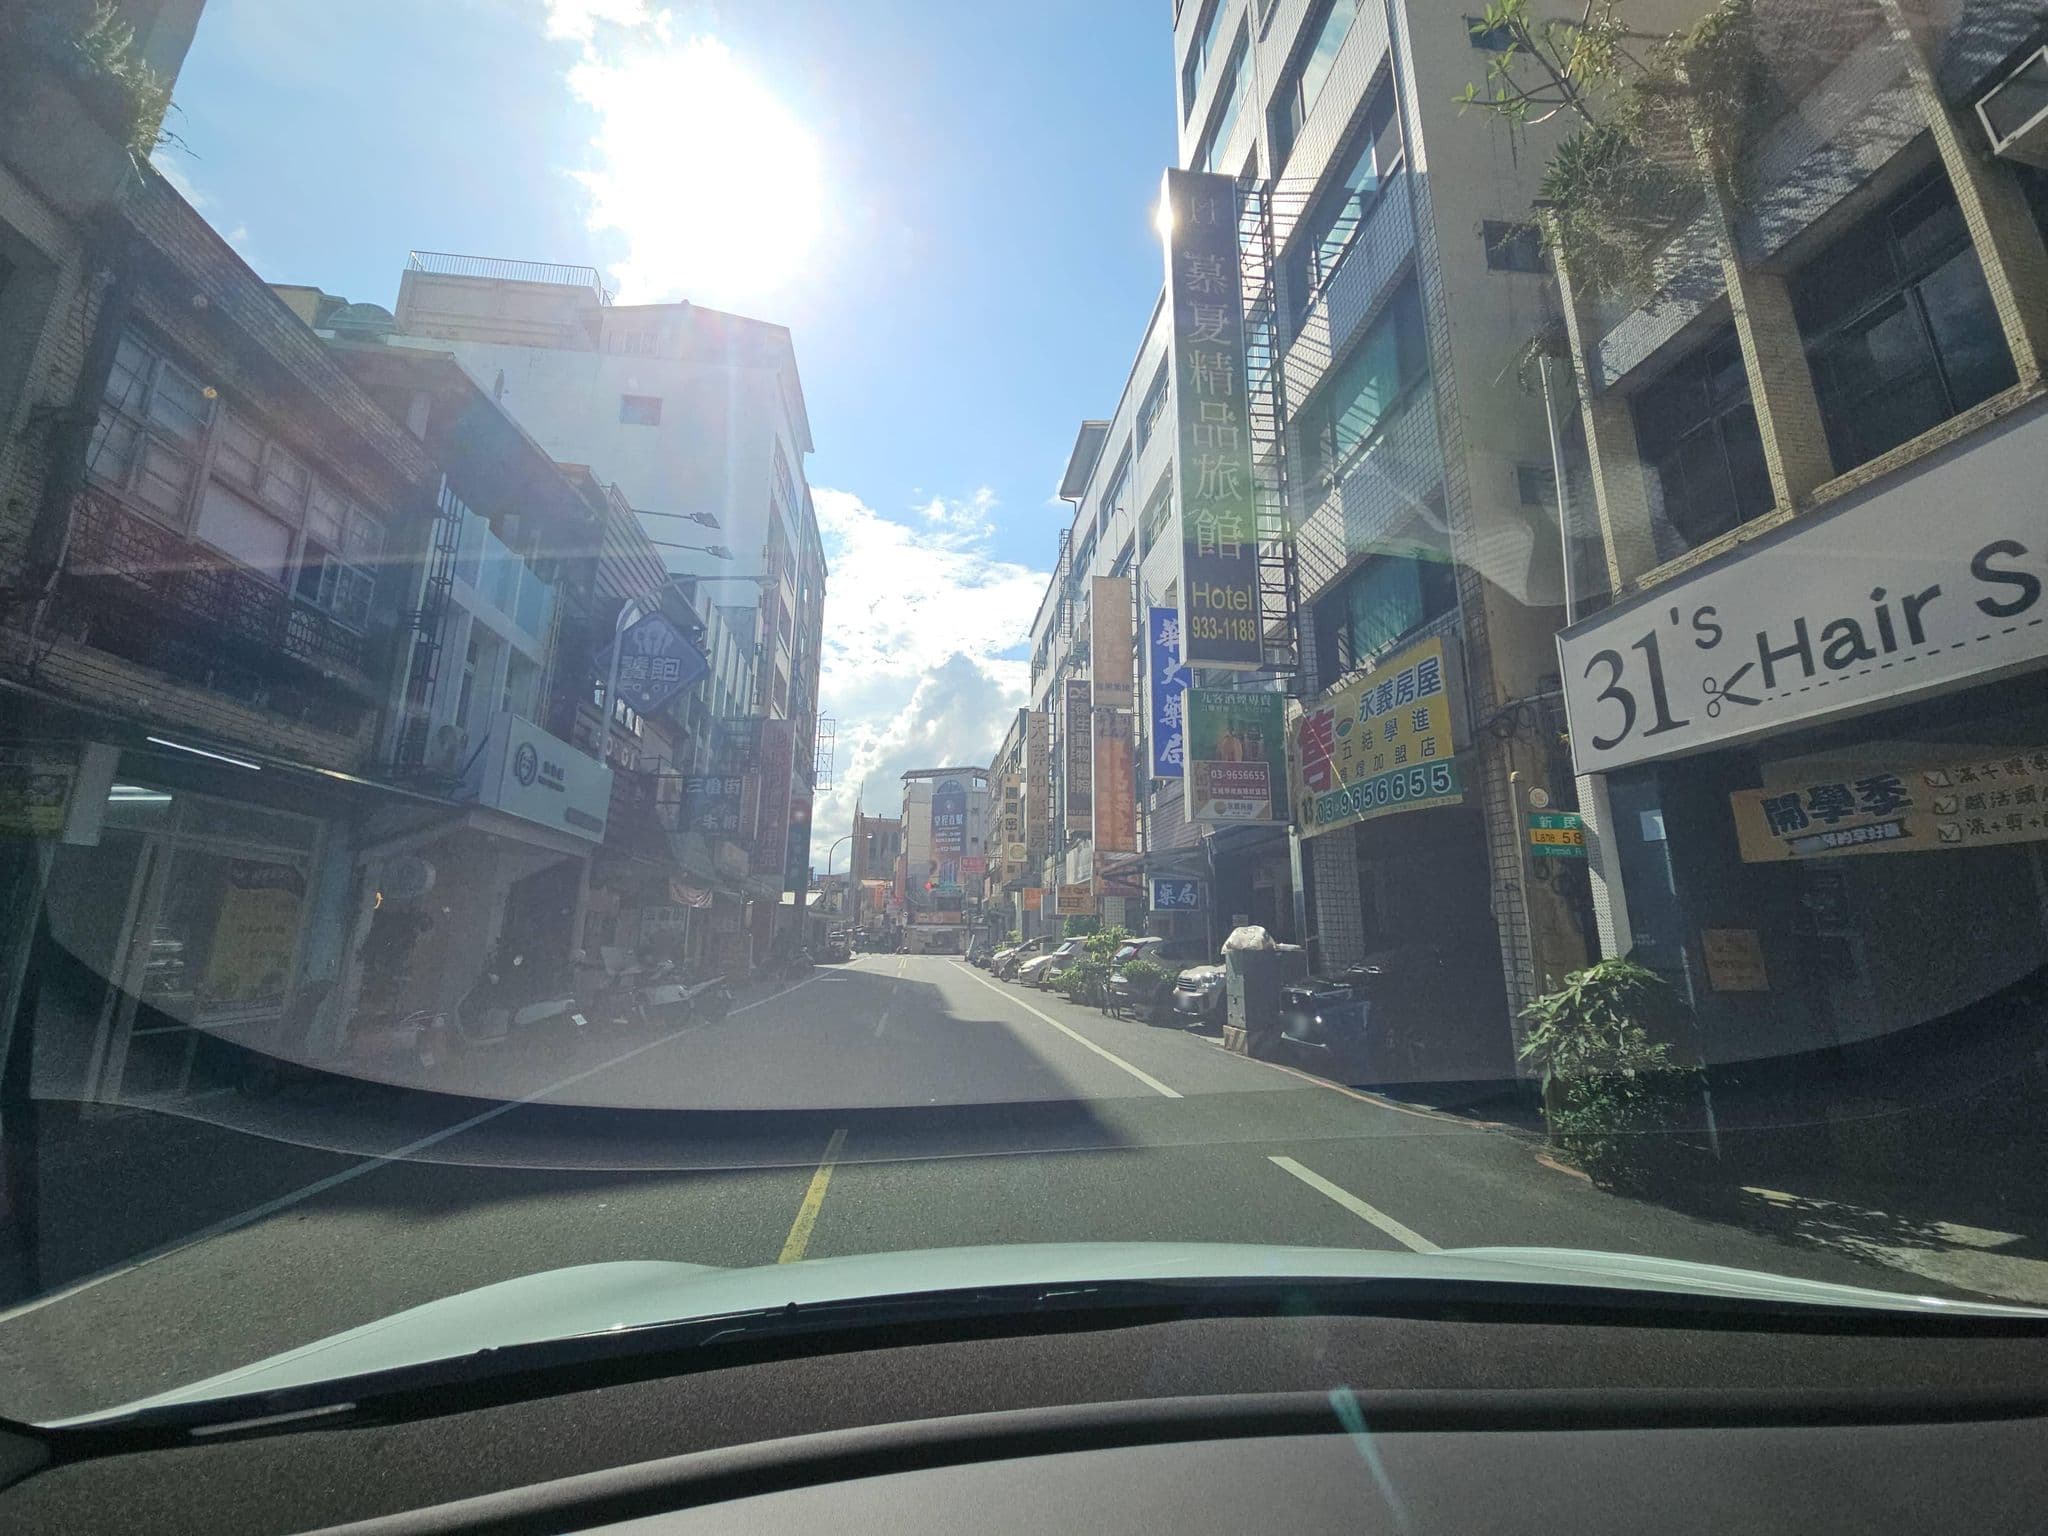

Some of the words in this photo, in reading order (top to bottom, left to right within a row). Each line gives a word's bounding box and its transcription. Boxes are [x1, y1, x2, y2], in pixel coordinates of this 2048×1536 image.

[1191, 581, 1254, 611] Hotel
[1191, 617, 1257, 642] 933-1188
[1583, 605, 1723, 752] 31's
[1756, 585, 1942, 690] Hair
[1971, 540, 2048, 618] S
[1156, 618, 1191, 766] 華大藥局
[1358, 656, 1443, 723] 永義房屋
[1300, 707, 1336, 795] 售
[1341, 706, 1430, 761] 五結學進
[1211, 769, 1266, 782] 03-9656655
[1318, 763, 1452, 825] 03-9656655
[1537, 816, 1577, 828] 新民
[1761, 773, 1913, 837] 開學季
[1535, 831, 1556, 843] Lane
[1562, 832, 1584, 845] 58
[1157, 883, 1198, 907] 藥局
